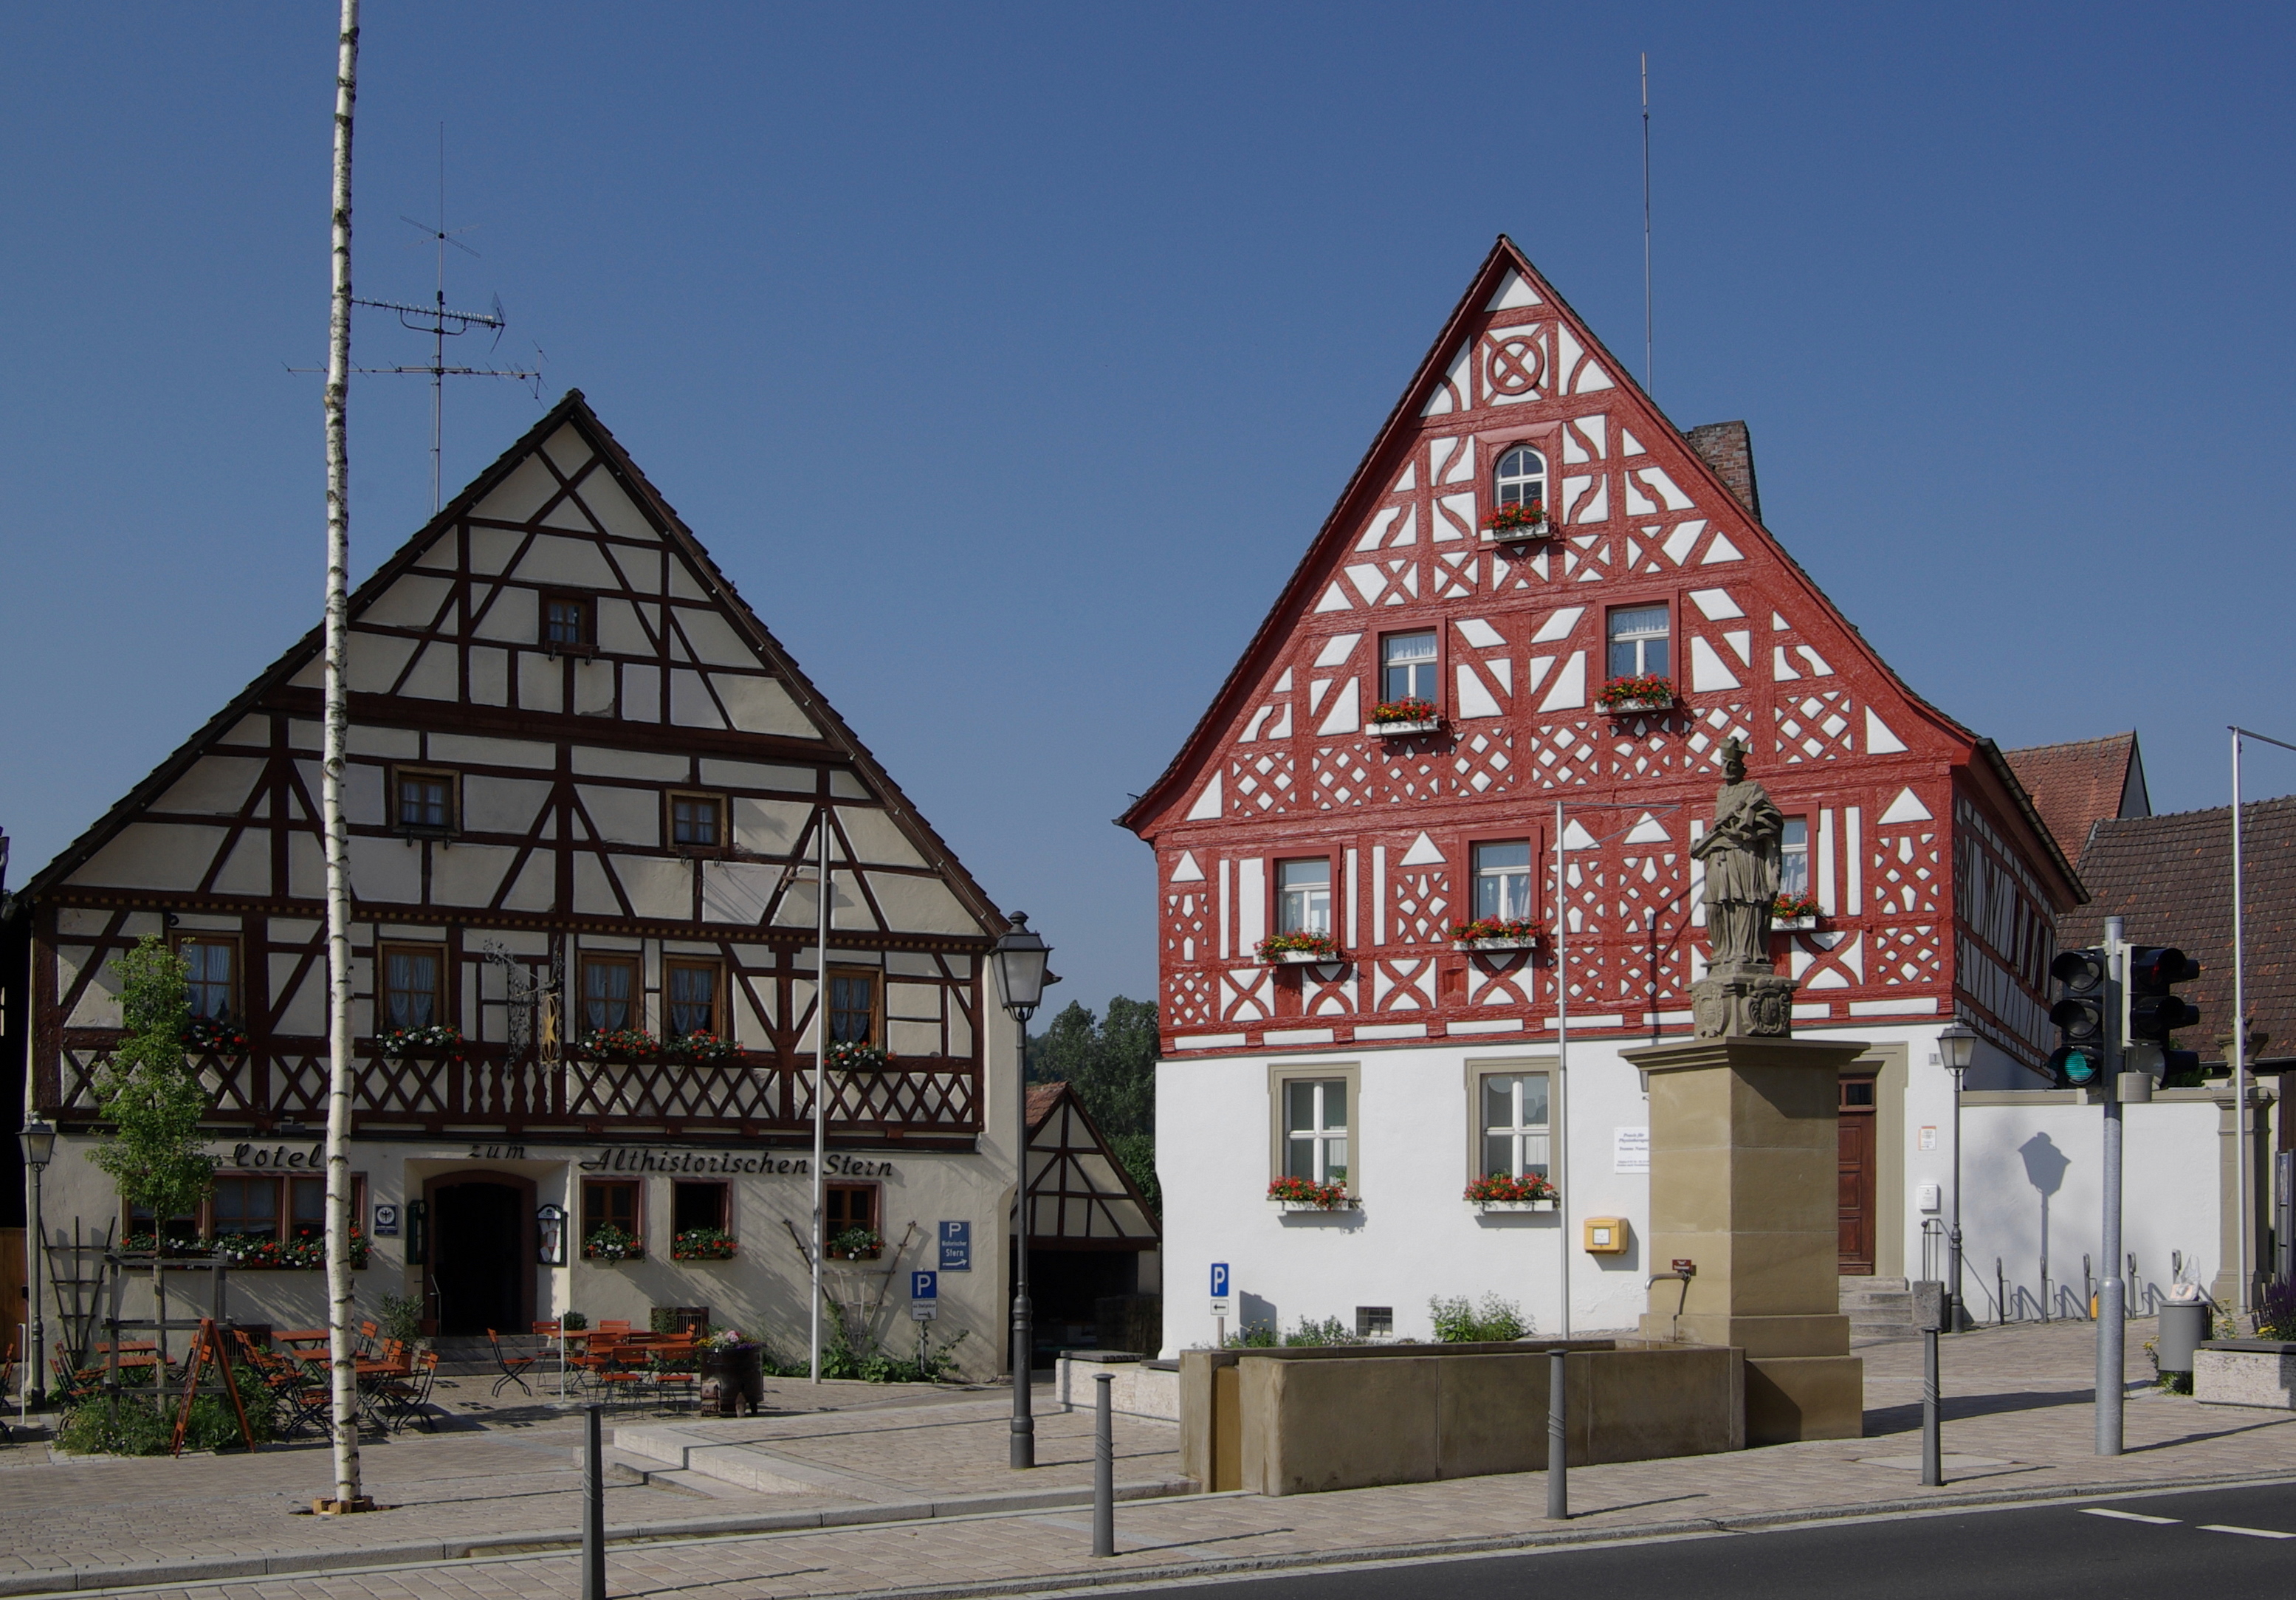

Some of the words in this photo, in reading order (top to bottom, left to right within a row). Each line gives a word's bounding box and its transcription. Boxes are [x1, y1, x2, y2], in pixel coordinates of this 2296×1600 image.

[468, 1145, 526, 1159] zum
[578, 1148, 809, 1175] Althistorischen
[822, 1154, 893, 1176] Stern
[949, 1222, 962, 1238] P
[946, 1248, 964, 1257] Stern
[917, 1274, 932, 1297] P
[1212, 1266, 1226, 1294] P
